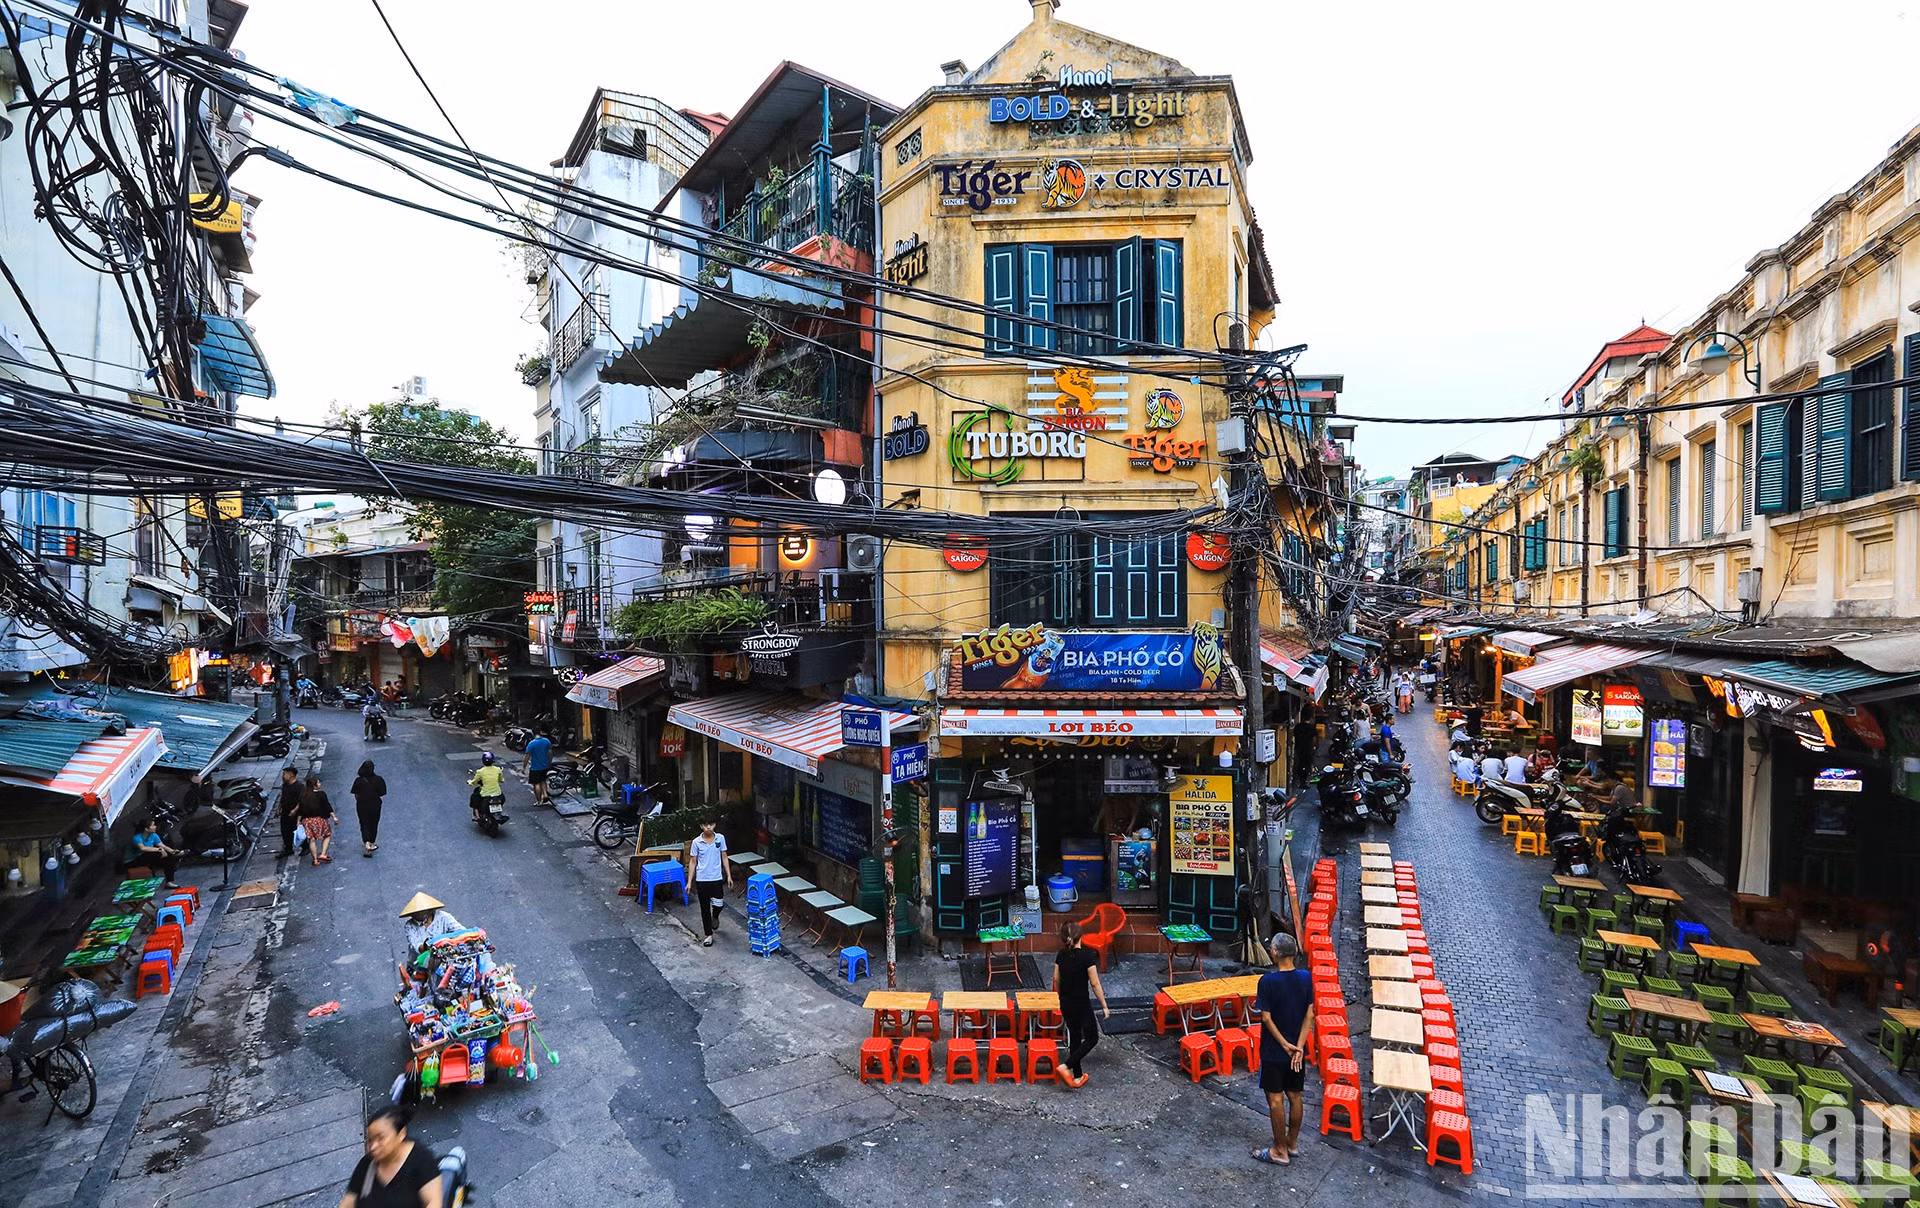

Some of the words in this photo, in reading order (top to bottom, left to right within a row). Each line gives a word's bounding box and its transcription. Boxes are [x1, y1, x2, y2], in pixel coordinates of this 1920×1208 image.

[1059, 62, 1113, 88] Hanoi
[990, 94, 1071, 124] BOLD
[1080, 99, 1096, 119] &
[1110, 90, 1185, 128] Light
[935, 160, 1032, 210] Tiger
[1114, 167, 1230, 189] CRYSTAL
[893, 232, 917, 257] Hanoi
[1065, 406, 1085, 416] BIA
[891, 411, 915, 432] Hanoi
[1043, 415, 1107, 431] SAIGON
[883, 429, 927, 461] BOLD
[966, 430, 1087, 461] TUBORG
[1123, 430, 1207, 472] Tiger
[1193, 553, 1223, 562] SAIGON
[741, 637, 800, 651] STRONGBOW
[952, 621, 1046, 667] Tiger
[770, 651, 792, 659] CIDERS
[1063, 651, 1100, 667] BIA
[1103, 645, 1150, 667] PHỐ
[1154, 644, 1185, 667] CỔ
[753, 660, 788, 677] CRYSTAL
[854, 715, 869, 725] PHỐ
[1090, 719, 1134, 733] BÉO
[707, 723, 721, 737] BÉO
[663, 743, 682, 754] 10K
[755, 742, 773, 756] BÉO
[903, 748, 916, 760] PHỐ
[895, 764, 905, 779] TẠ
[906, 758, 924, 777] HIỆN
[1184, 790, 1217, 800] HALIDA
[1175, 803, 1190, 811] BIA
[1192, 803, 1212, 812] PHỐ
